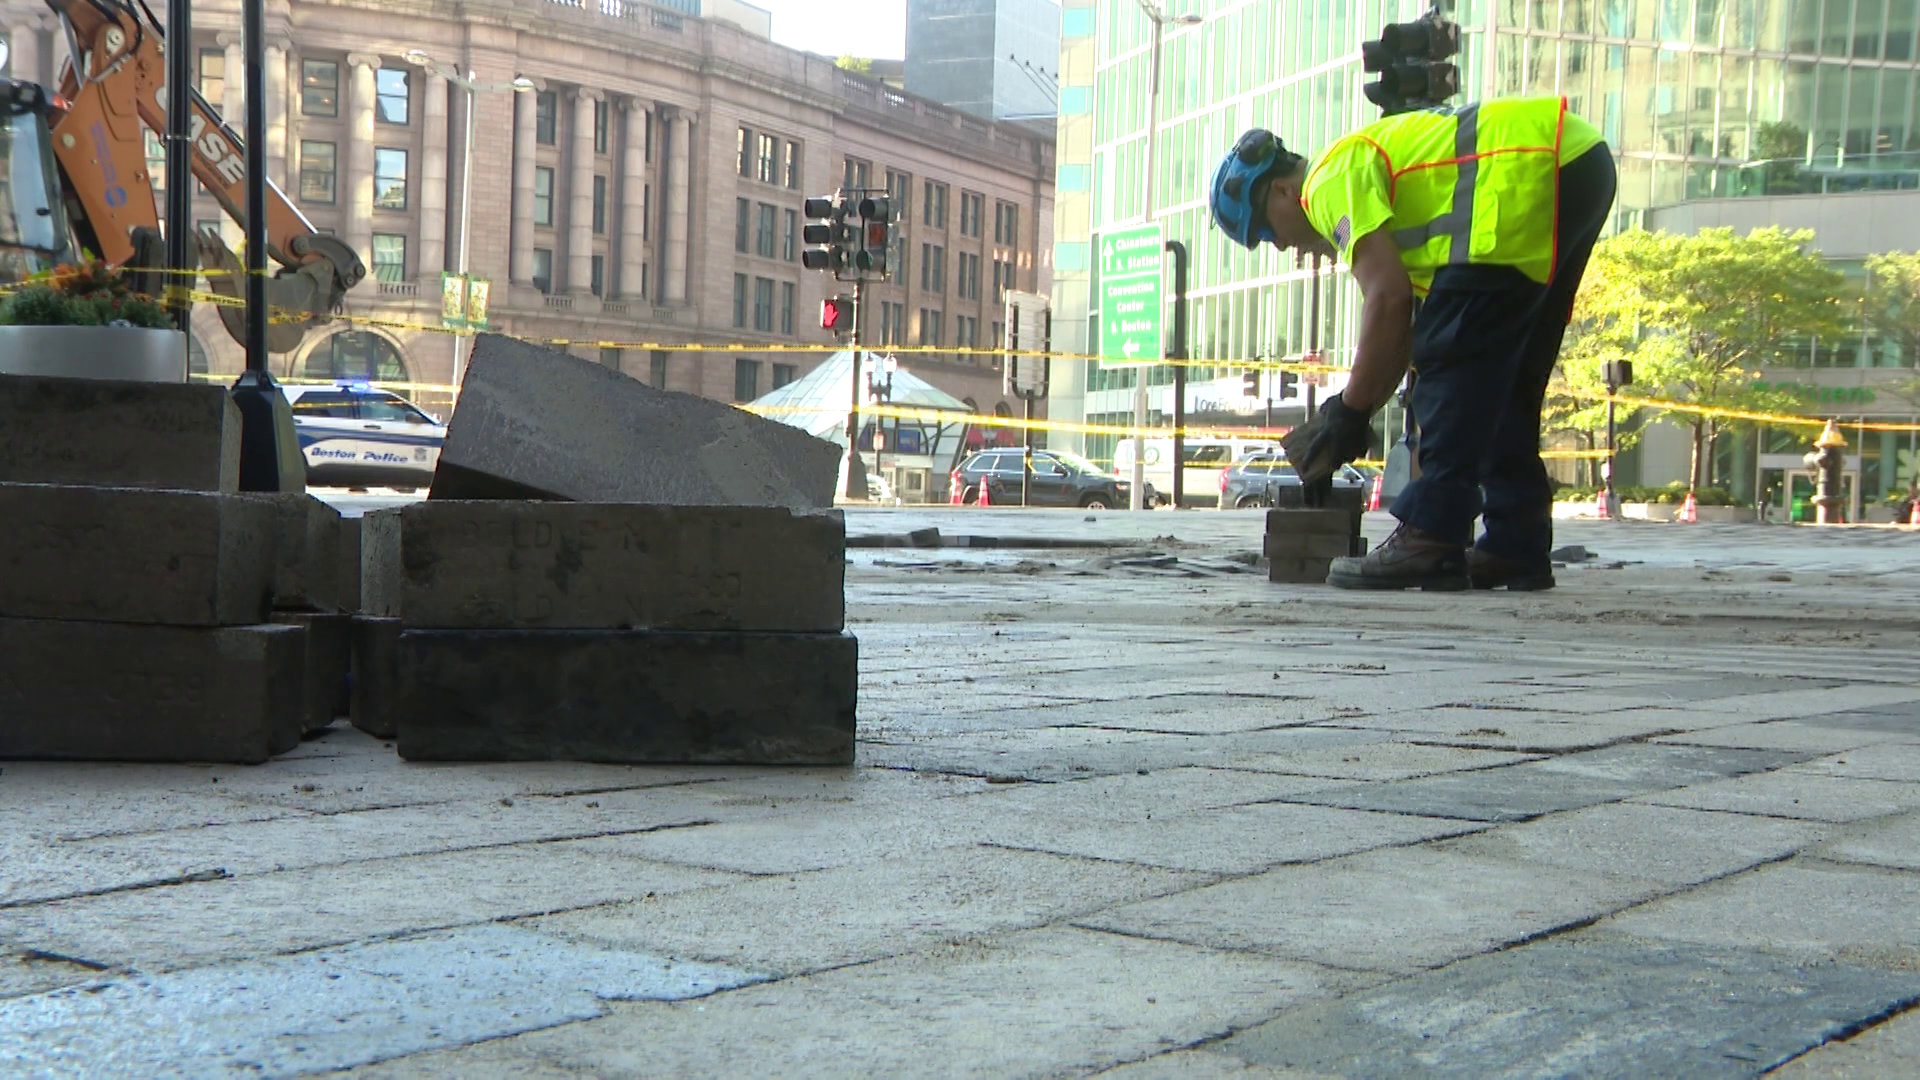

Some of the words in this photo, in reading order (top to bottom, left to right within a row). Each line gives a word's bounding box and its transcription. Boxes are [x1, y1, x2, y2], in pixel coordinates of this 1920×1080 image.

[1116, 235, 1160, 251] Chinatown
[1128, 255, 1160, 269] Station
[1108, 281, 1154, 297] Convention
[1116, 300, 1144, 313] Center
[1121, 319, 1151, 333] Boston
[1776, 382, 1875, 403] Ciizens
[311, 447, 356, 458] Boston
[363, 451, 409, 462] Police
